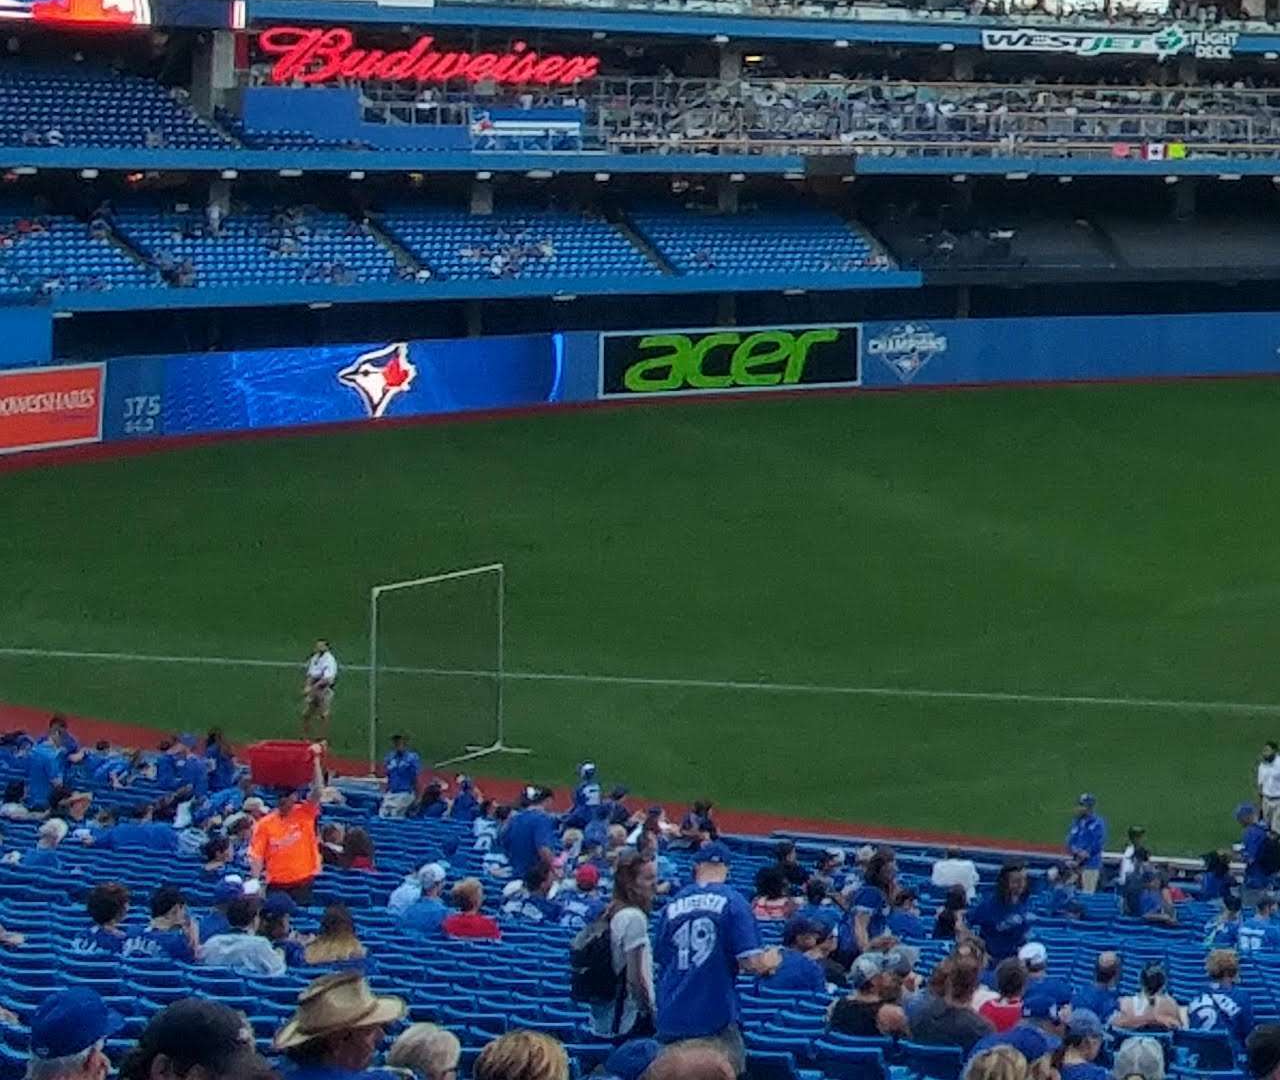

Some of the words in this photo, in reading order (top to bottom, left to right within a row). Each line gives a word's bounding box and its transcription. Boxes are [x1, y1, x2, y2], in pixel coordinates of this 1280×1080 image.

[259, 25, 600, 84] Budweiser
[986, 30, 1153, 55] WESTJET
[1195, 45, 1232, 59] DECK
[624, 328, 838, 392] acer
[868, 334, 947, 354] CHAMPIONS
[672, 917, 716, 970] 19
